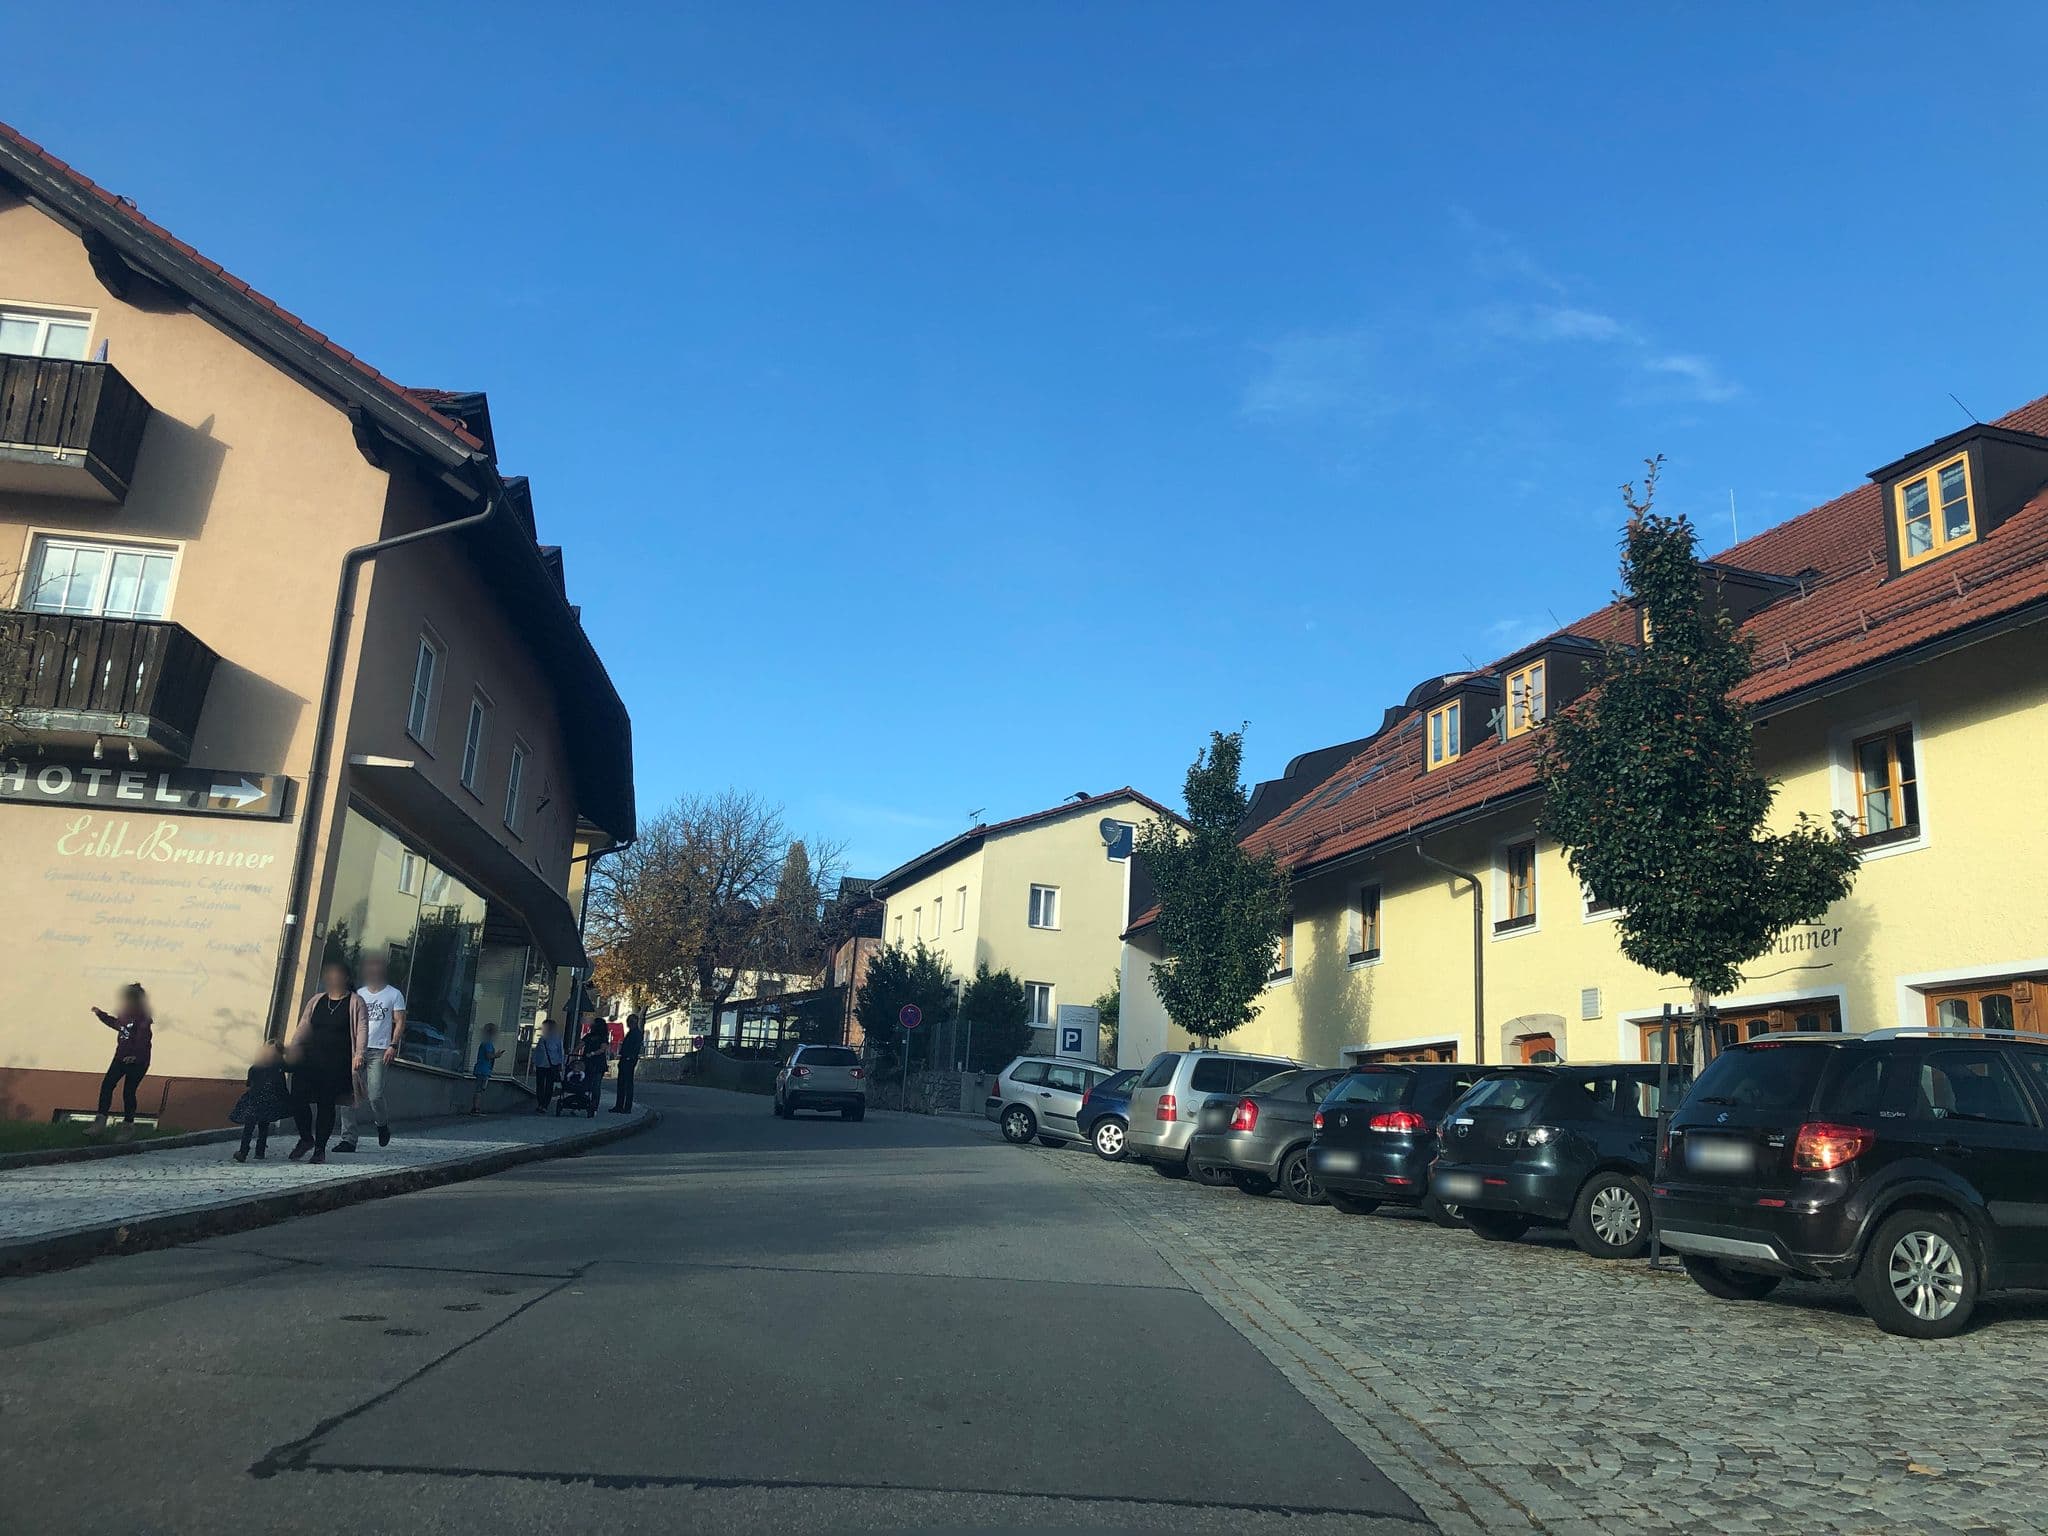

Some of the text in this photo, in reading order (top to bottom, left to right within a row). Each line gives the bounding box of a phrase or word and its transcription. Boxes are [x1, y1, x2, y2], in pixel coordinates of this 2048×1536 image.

[0, 762, 182, 802] HOTEL
[57, 815, 274, 869] Eibl-Brunner
[1065, 1031, 1079, 1048] P
